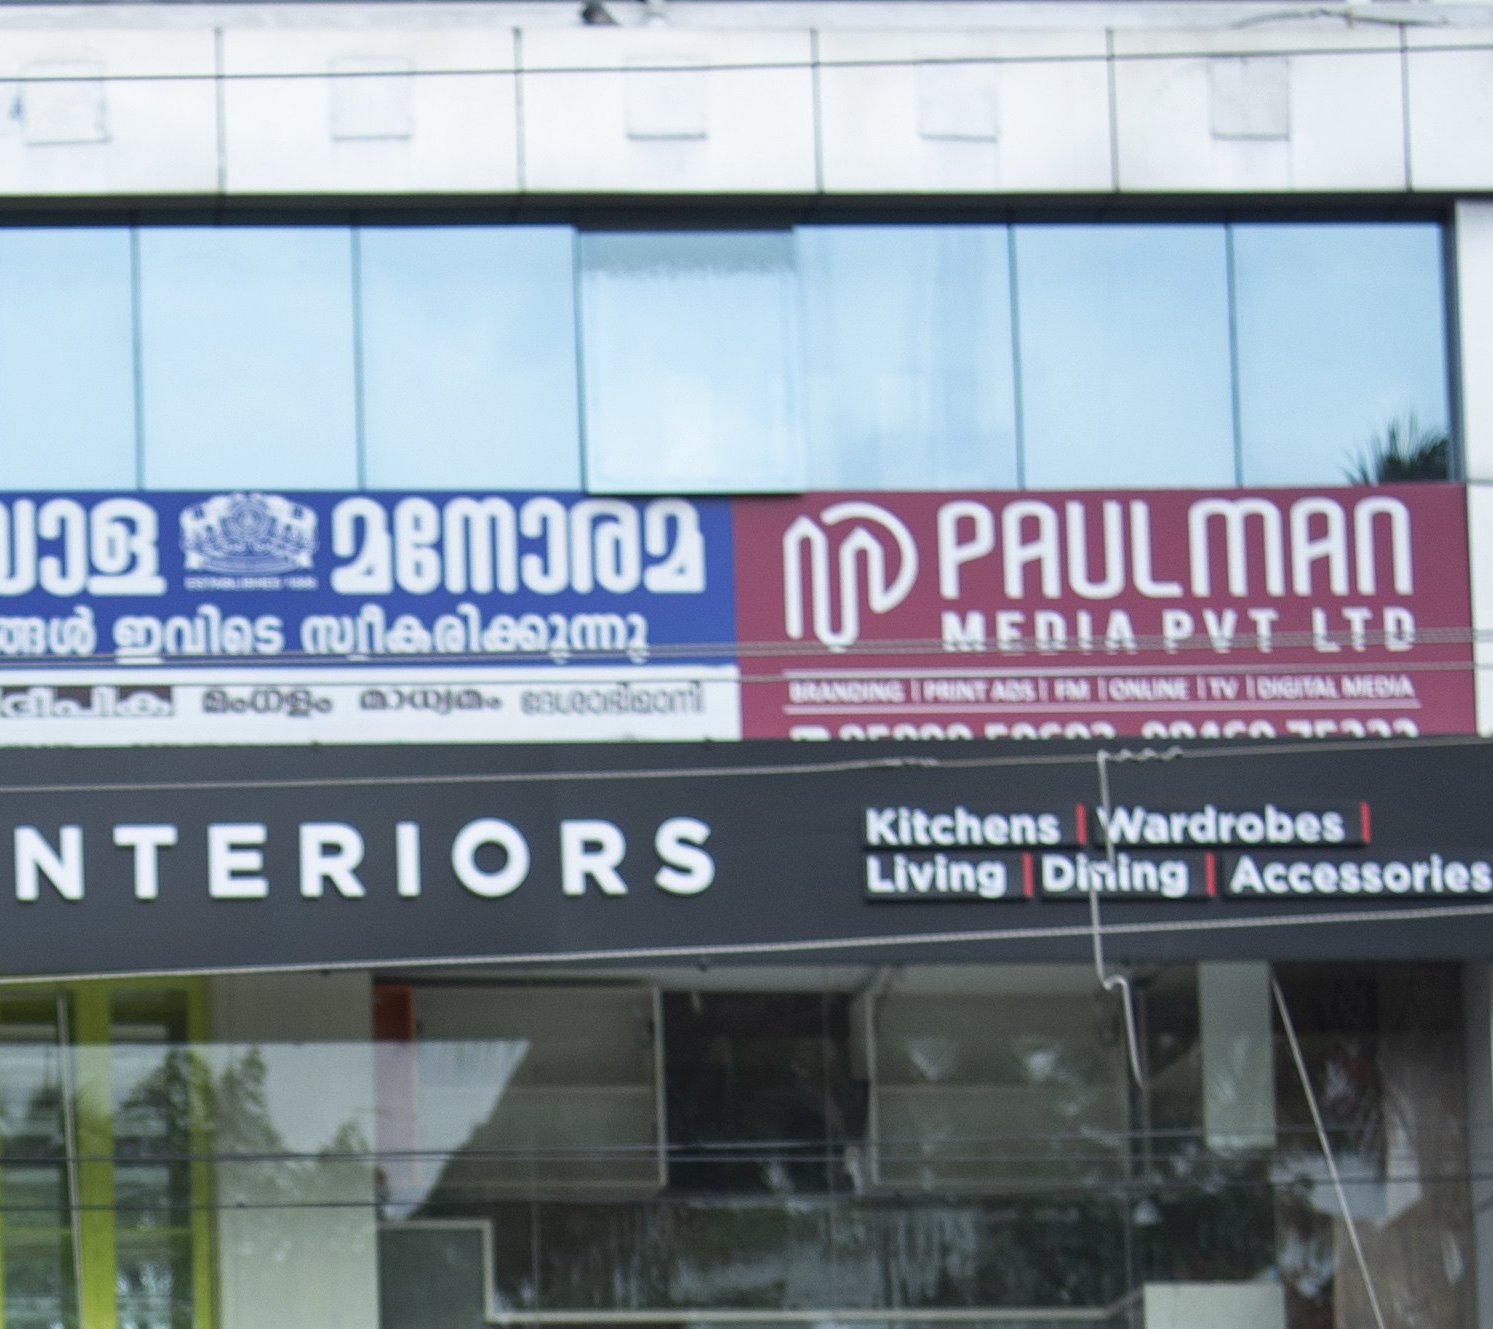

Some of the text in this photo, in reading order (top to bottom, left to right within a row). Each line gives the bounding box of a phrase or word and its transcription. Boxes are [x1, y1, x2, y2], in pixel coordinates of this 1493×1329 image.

[331, 497, 706, 596] മനോരമ
[938, 497, 1414, 599] PAULMAN
[941, 607, 1416, 655] MEDIA PVT LTD
[789, 680, 905, 704] BRANDING
[923, 679, 985, 703] PRINT
[991, 678, 1037, 702] ADS
[1109, 677, 1189, 702] ONLINE
[1209, 676, 1239, 700] TV
[1257, 675, 1339, 700] DIGITAL
[1341, 674, 1415, 699] MEDIA
[864, 803, 1345, 846] Kitchens Wardrobes
[865, 854, 1007, 901] Living
[1042, 851, 1189, 901] Dining
